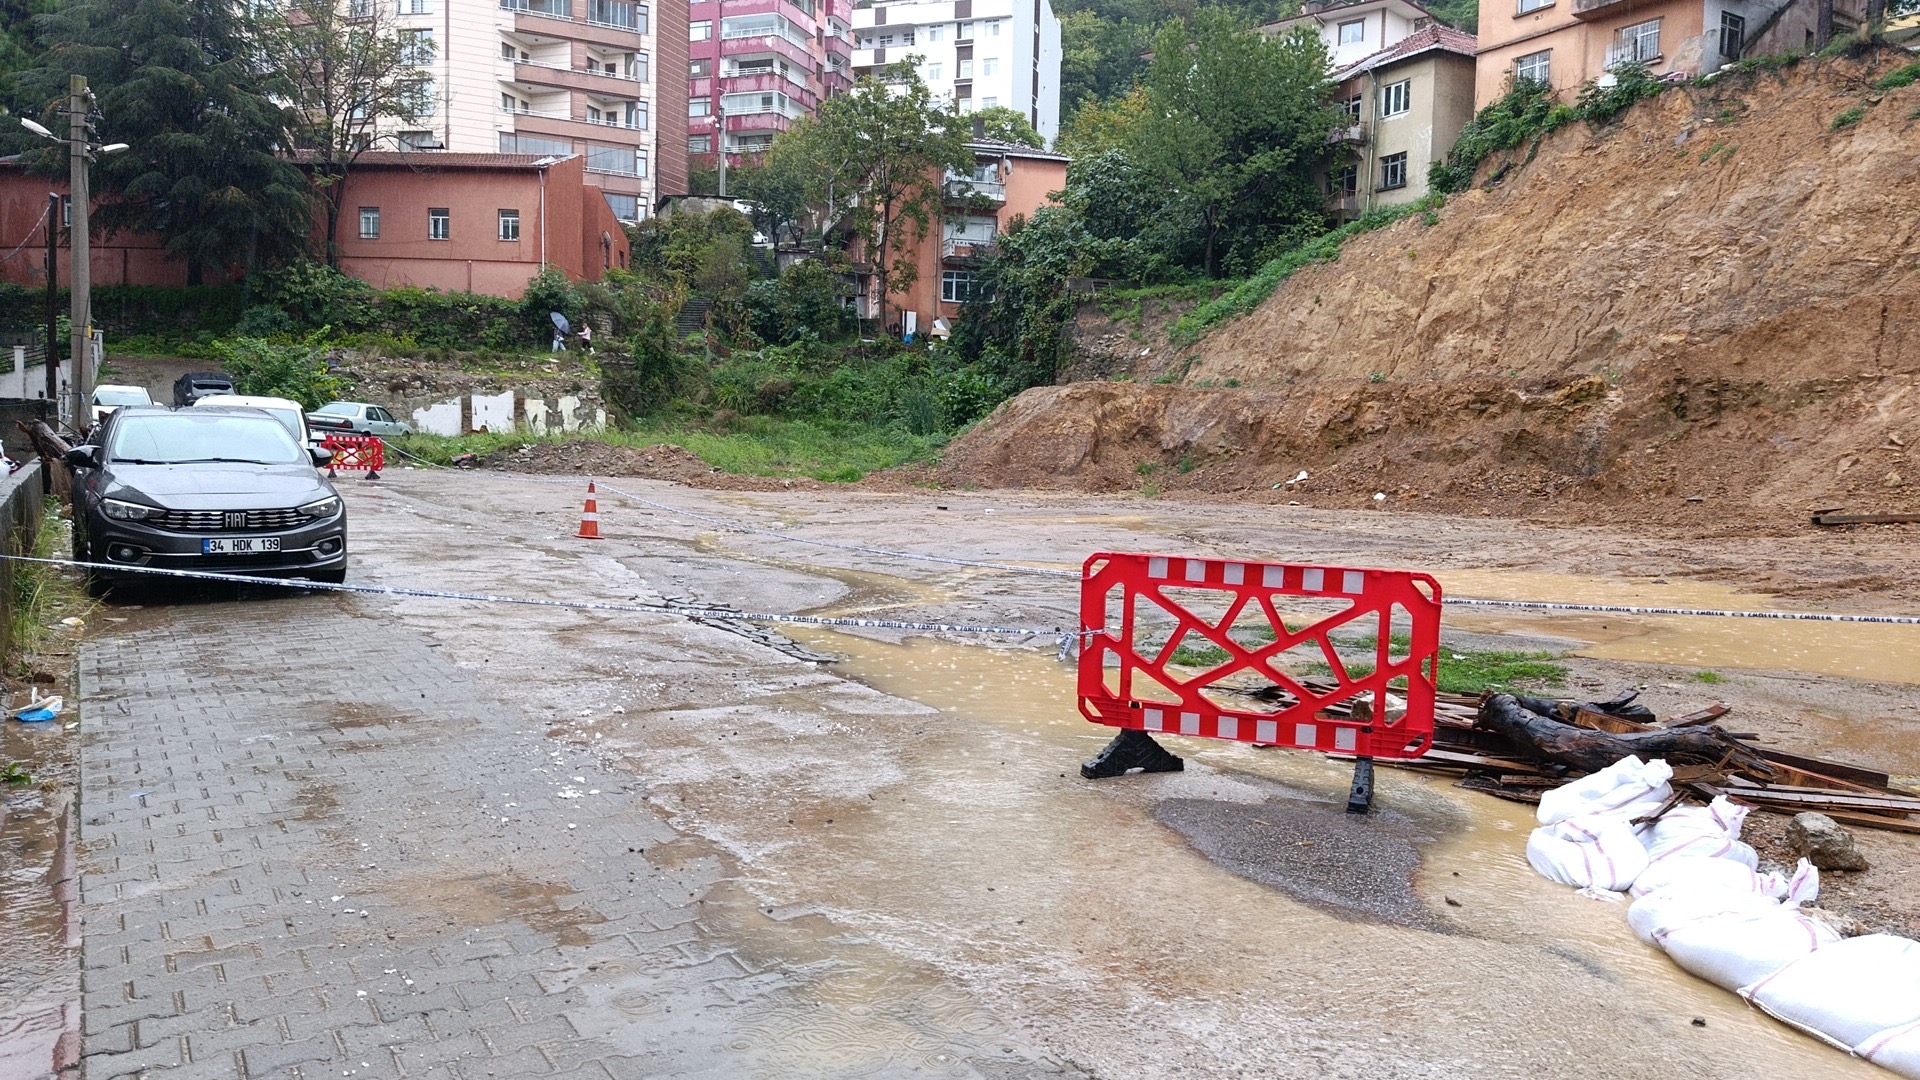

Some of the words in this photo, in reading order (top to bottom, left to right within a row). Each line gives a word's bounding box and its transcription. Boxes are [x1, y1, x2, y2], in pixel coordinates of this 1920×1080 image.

[225, 512, 247, 528] FIAT
[210, 540, 224, 551] 34
[232, 540, 253, 550] HDK
[261, 539, 279, 550] 139
[834, 618, 859, 626] ZABITA
[878, 620, 902, 629] ZABITA
